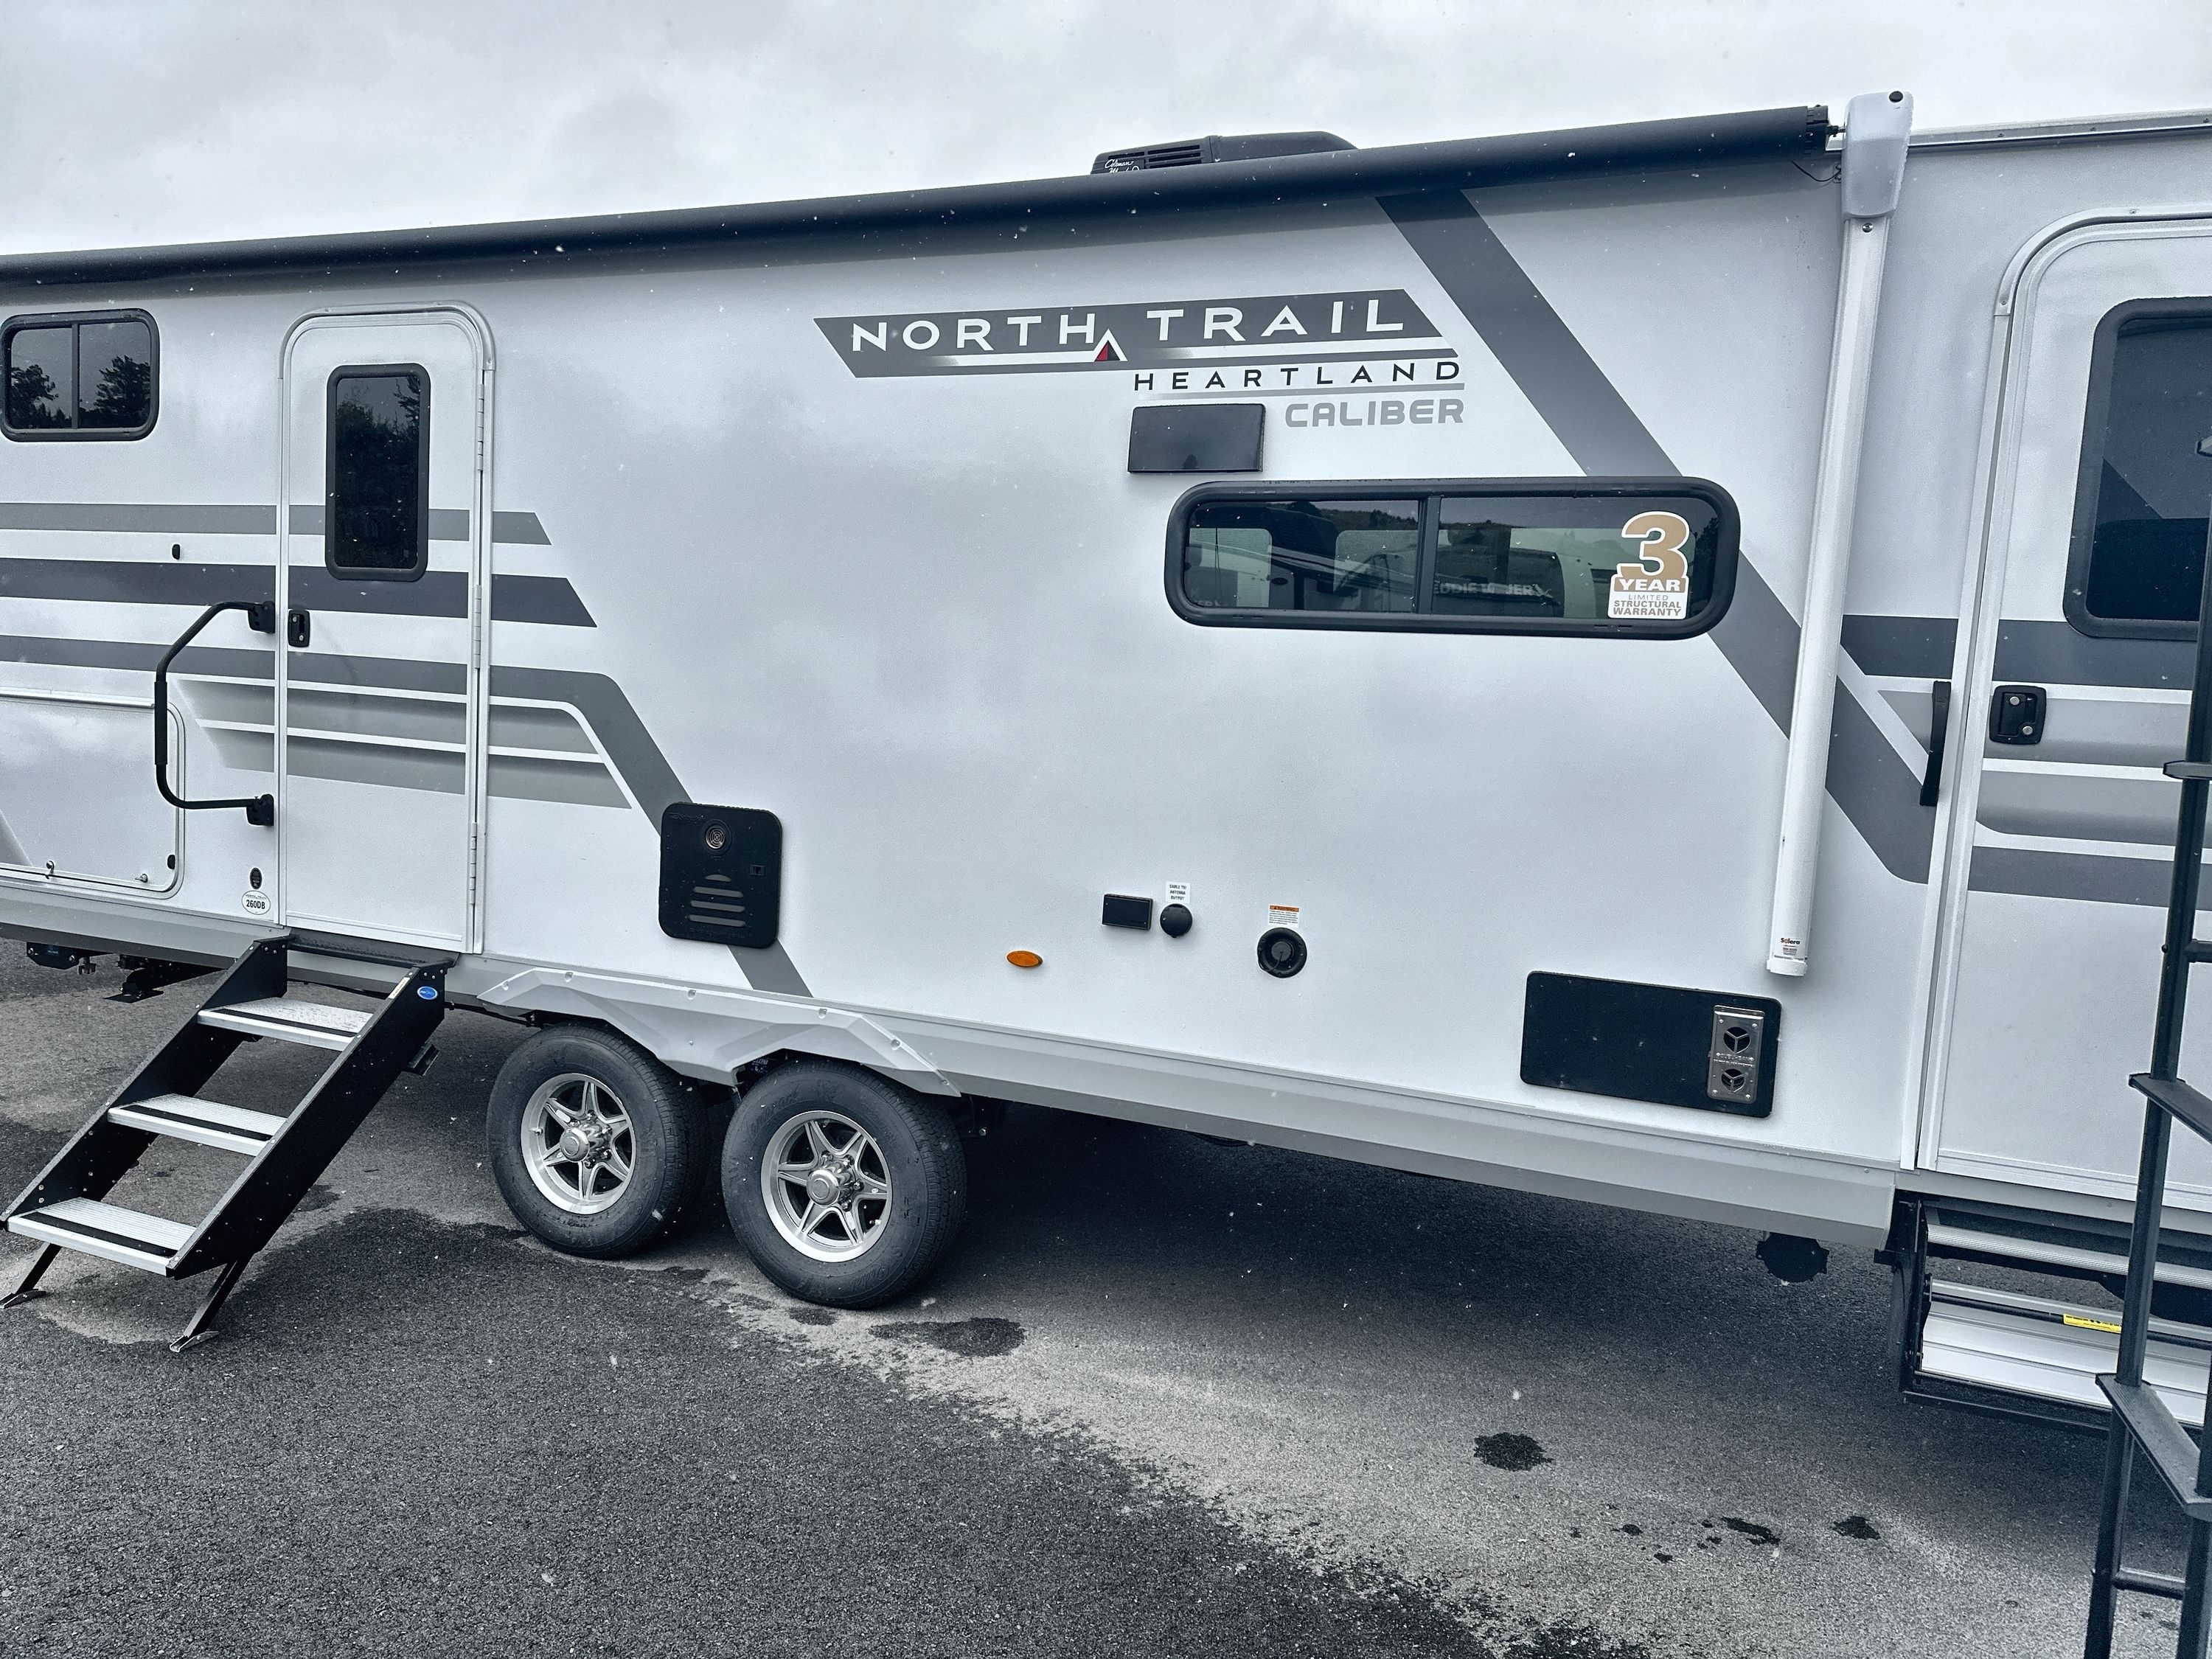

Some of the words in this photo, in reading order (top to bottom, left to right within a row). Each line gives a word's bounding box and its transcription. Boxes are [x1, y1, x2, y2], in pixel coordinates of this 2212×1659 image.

[852, 313, 1096, 352] NORTH
[1147, 300, 1405, 342] TRAIL
[1134, 361, 1460, 392] HEARTLAND
[1285, 399, 1464, 428] CALIBER
[1617, 511, 1690, 579] 3
[1619, 579, 1681, 591] YEAR
[1613, 607, 1682, 616] WARRANTY
[1614, 600, 1682, 608] STRUCTURAL
[246, 899, 265, 909] 260DB
